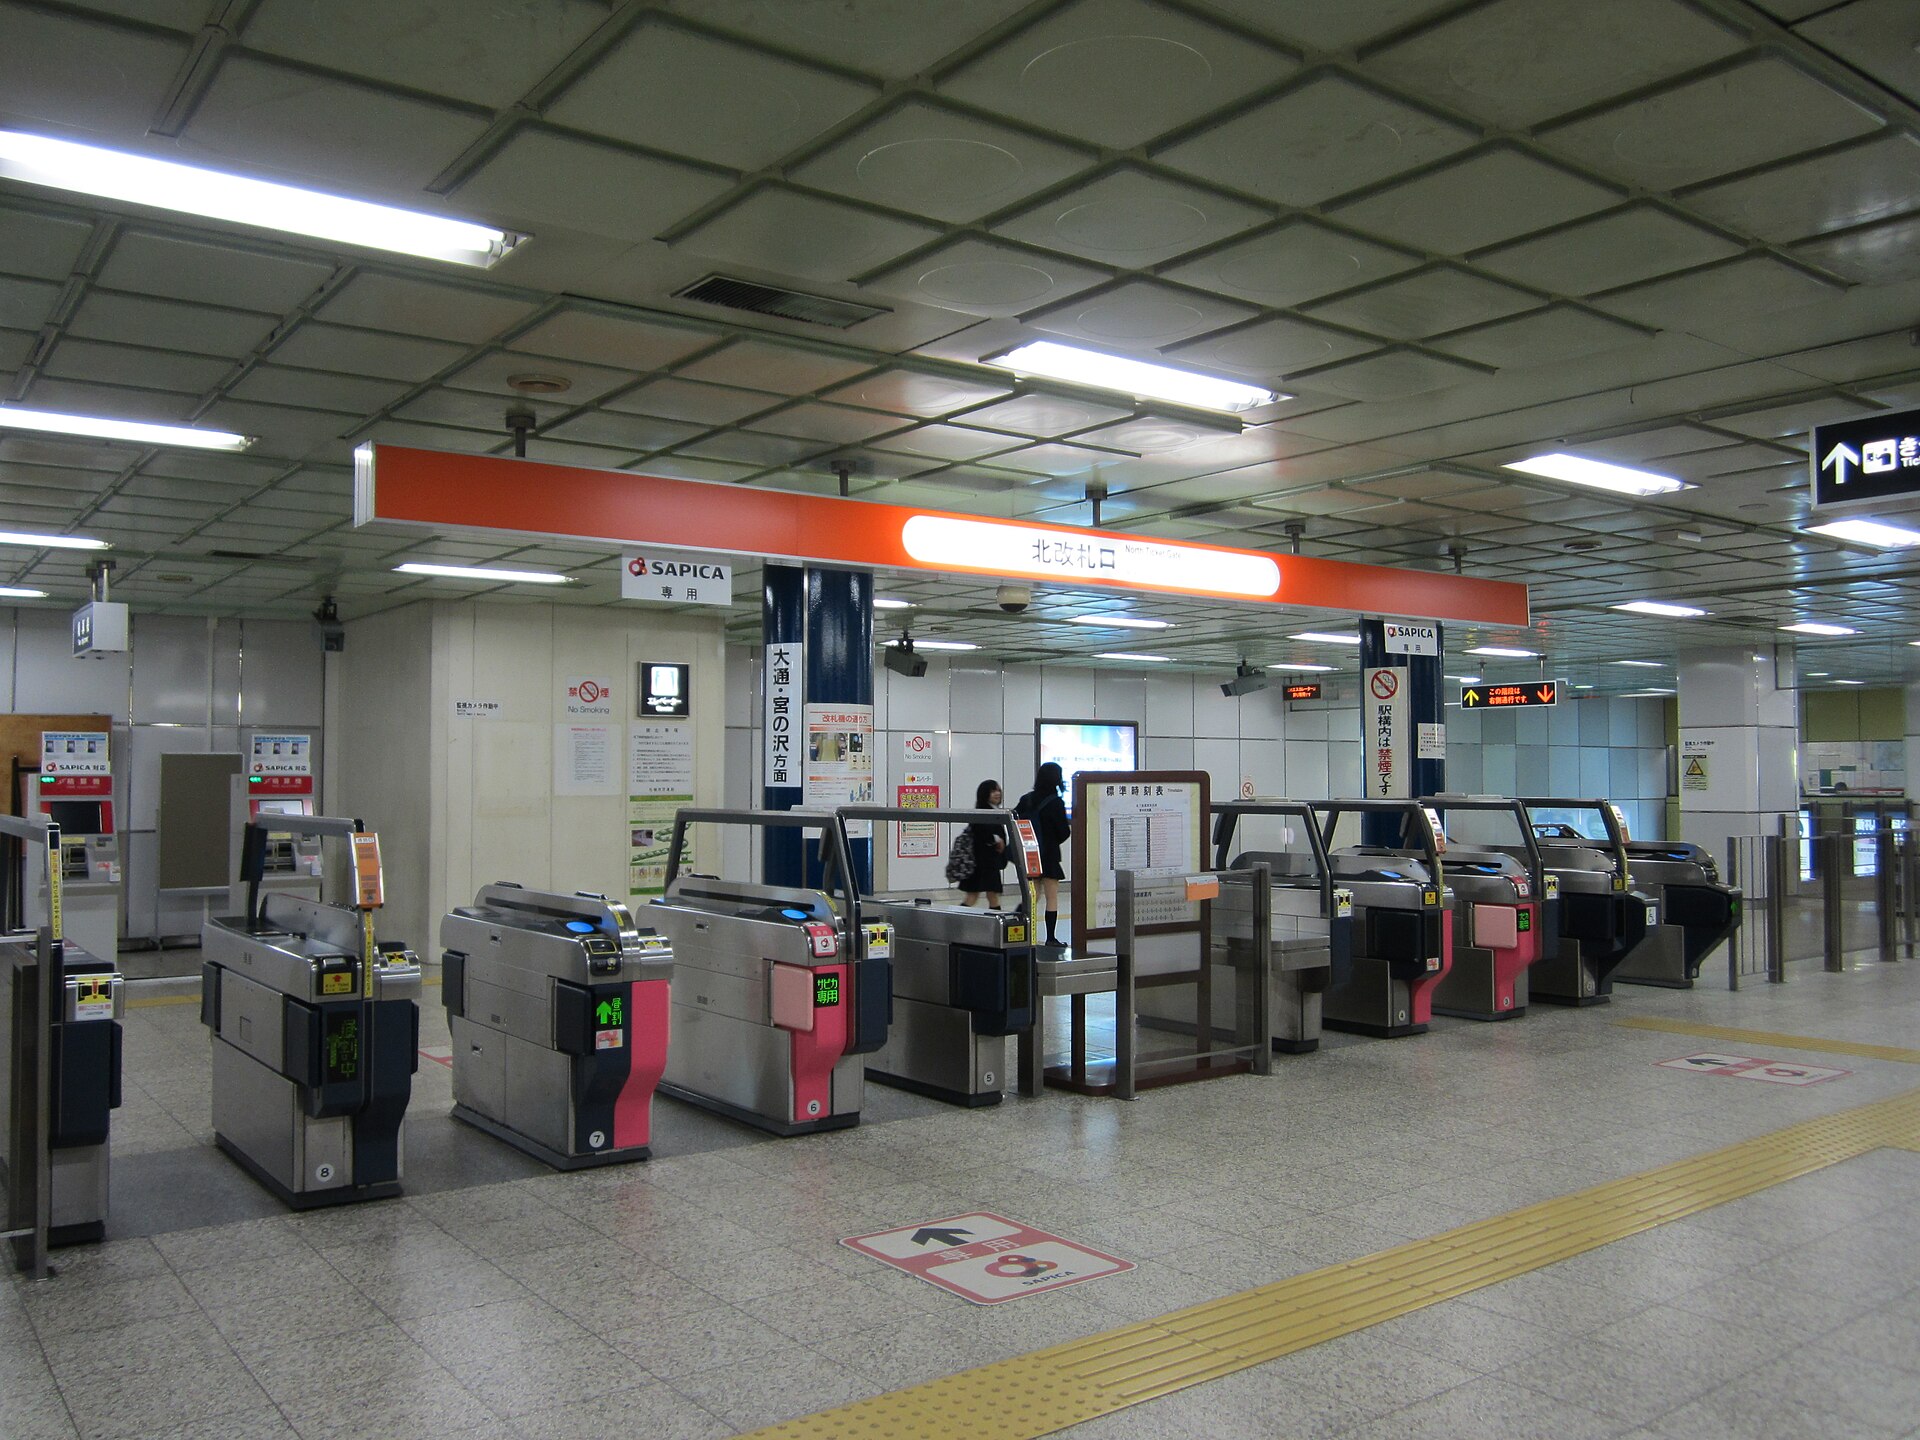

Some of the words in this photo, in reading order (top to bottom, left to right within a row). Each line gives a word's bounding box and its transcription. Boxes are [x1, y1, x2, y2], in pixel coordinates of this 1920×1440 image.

[1899, 436, 1920, 457] き
[1900, 455, 1920, 467] Tic
[1032, 539, 1115, 569] 北改札口
[651, 561, 725, 580] SAPICA
[661, 585, 698, 600] 専用
[1398, 626, 1433, 638] SAPICA
[1489, 687, 1520, 695] この階段は
[568, 705, 578, 713] No
[580, 705, 610, 714] Smoking
[773, 648, 790, 783] 大通・宮の沢方面
[822, 714, 868, 724] 改札機の通り方
[1377, 704, 1393, 797] 駅構内は禁煙です
[1106, 785, 1163, 797] 標準時刻表
[817, 978, 838, 990] サピカ
[817, 990, 838, 1004] 専用
[810, 1103, 817, 1112] 6
[593, 1135, 601, 1144] 7
[320, 1167, 330, 1178] 8
[1022, 1270, 1076, 1287] SAPICA
